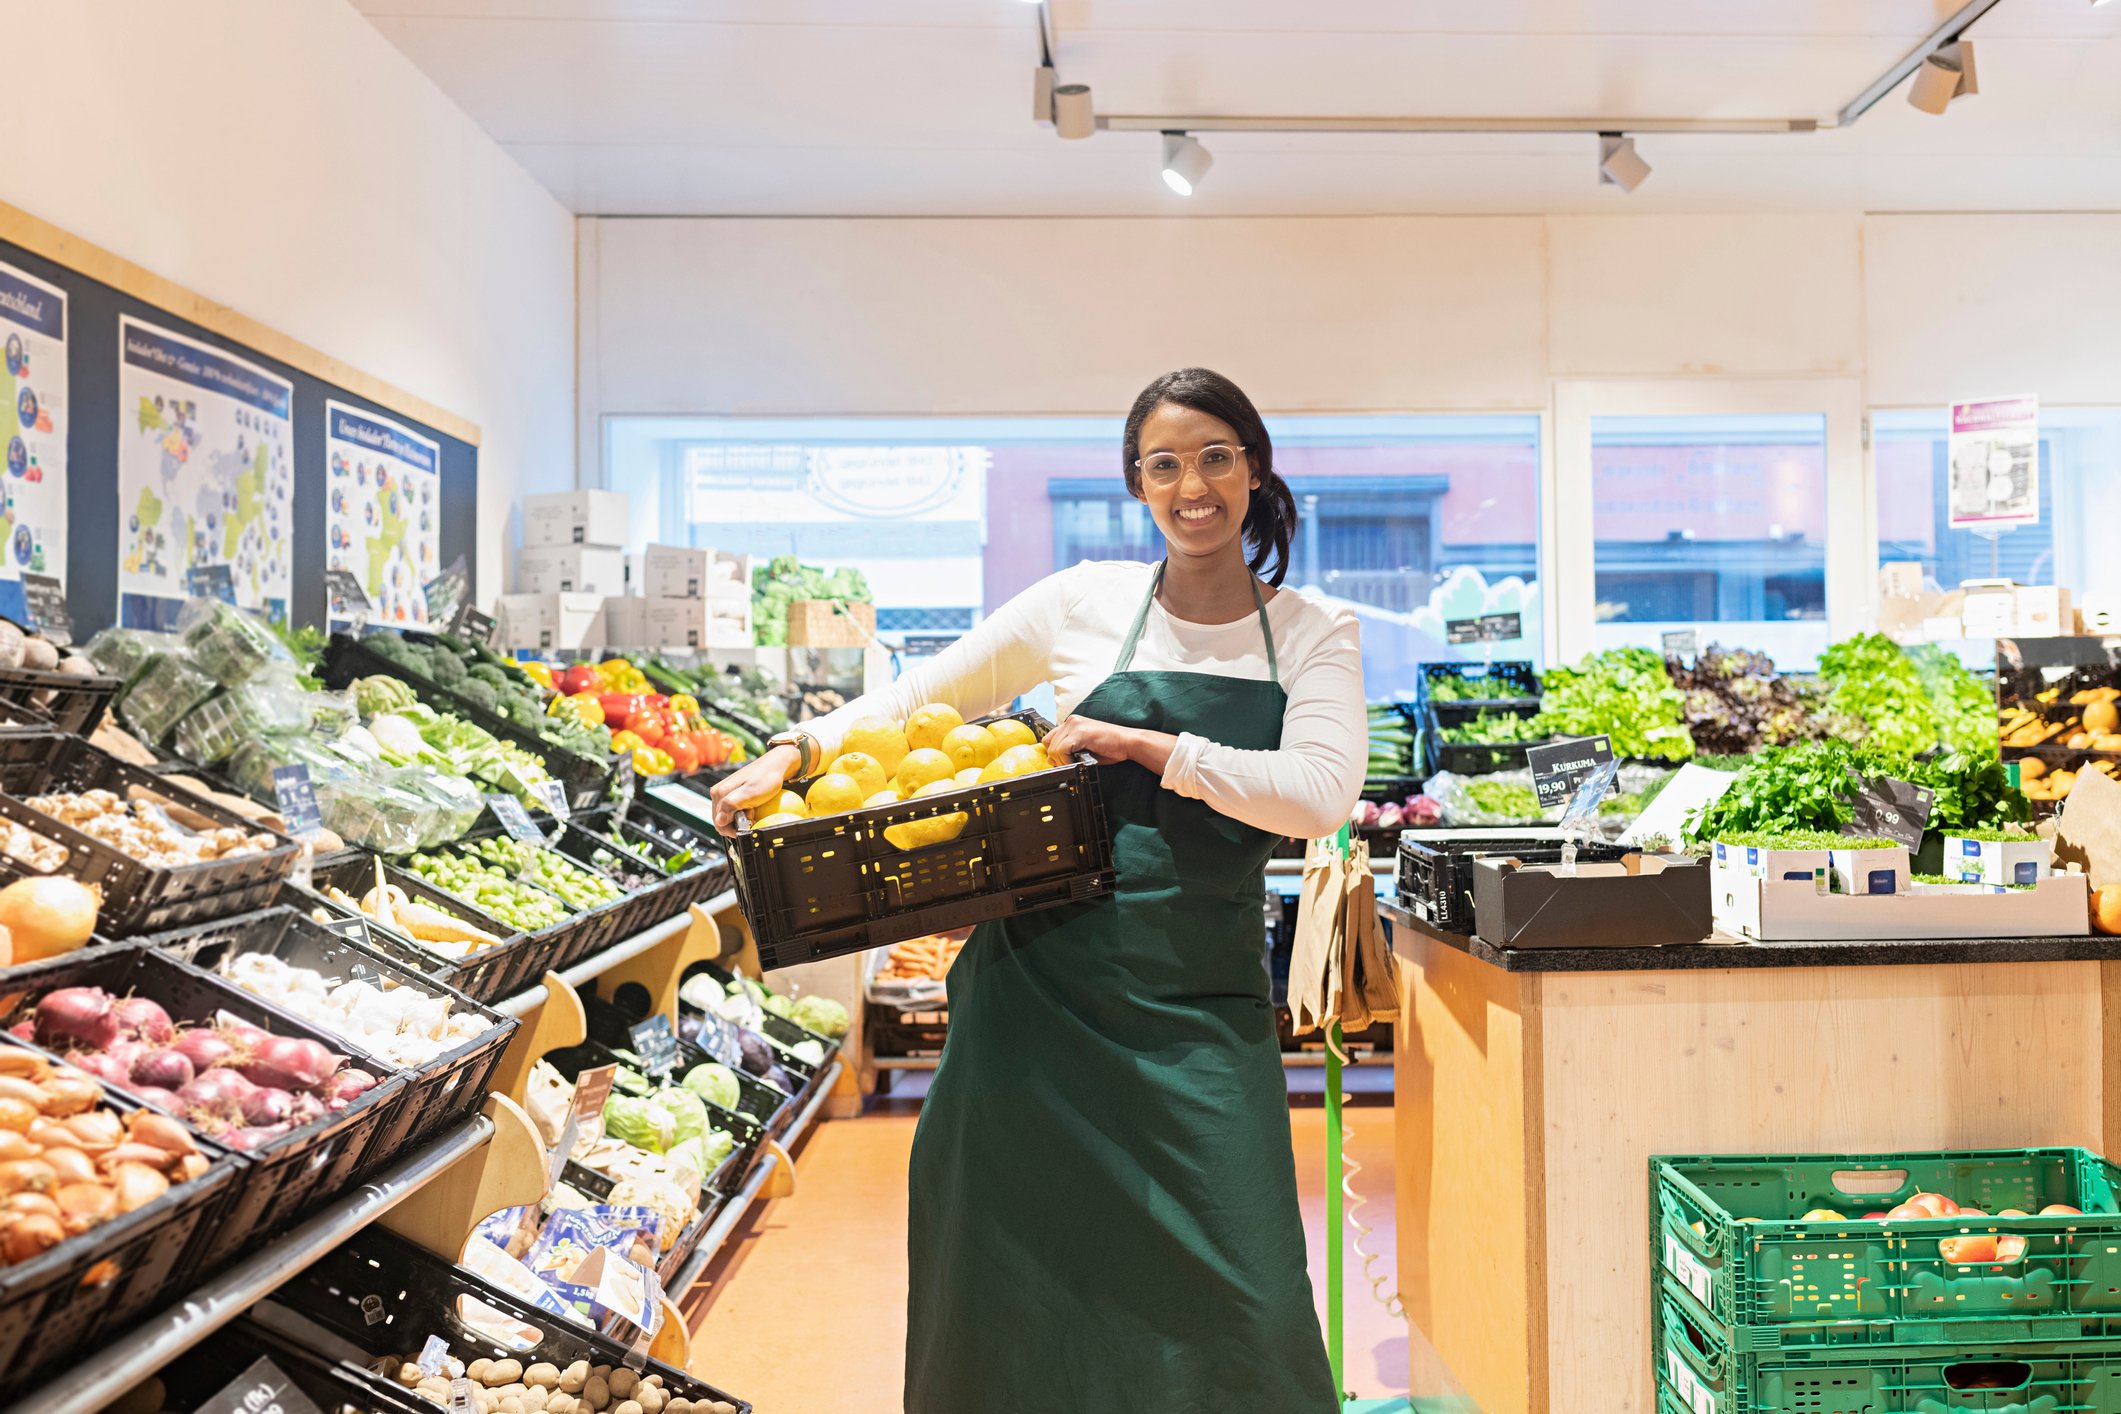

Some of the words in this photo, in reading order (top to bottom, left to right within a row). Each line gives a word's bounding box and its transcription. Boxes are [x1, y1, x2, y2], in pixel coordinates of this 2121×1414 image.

[1551, 758, 1597, 774] KURKUMA
[1537, 780, 1566, 795] 19,90
[1438, 890, 1449, 920] LL4310
